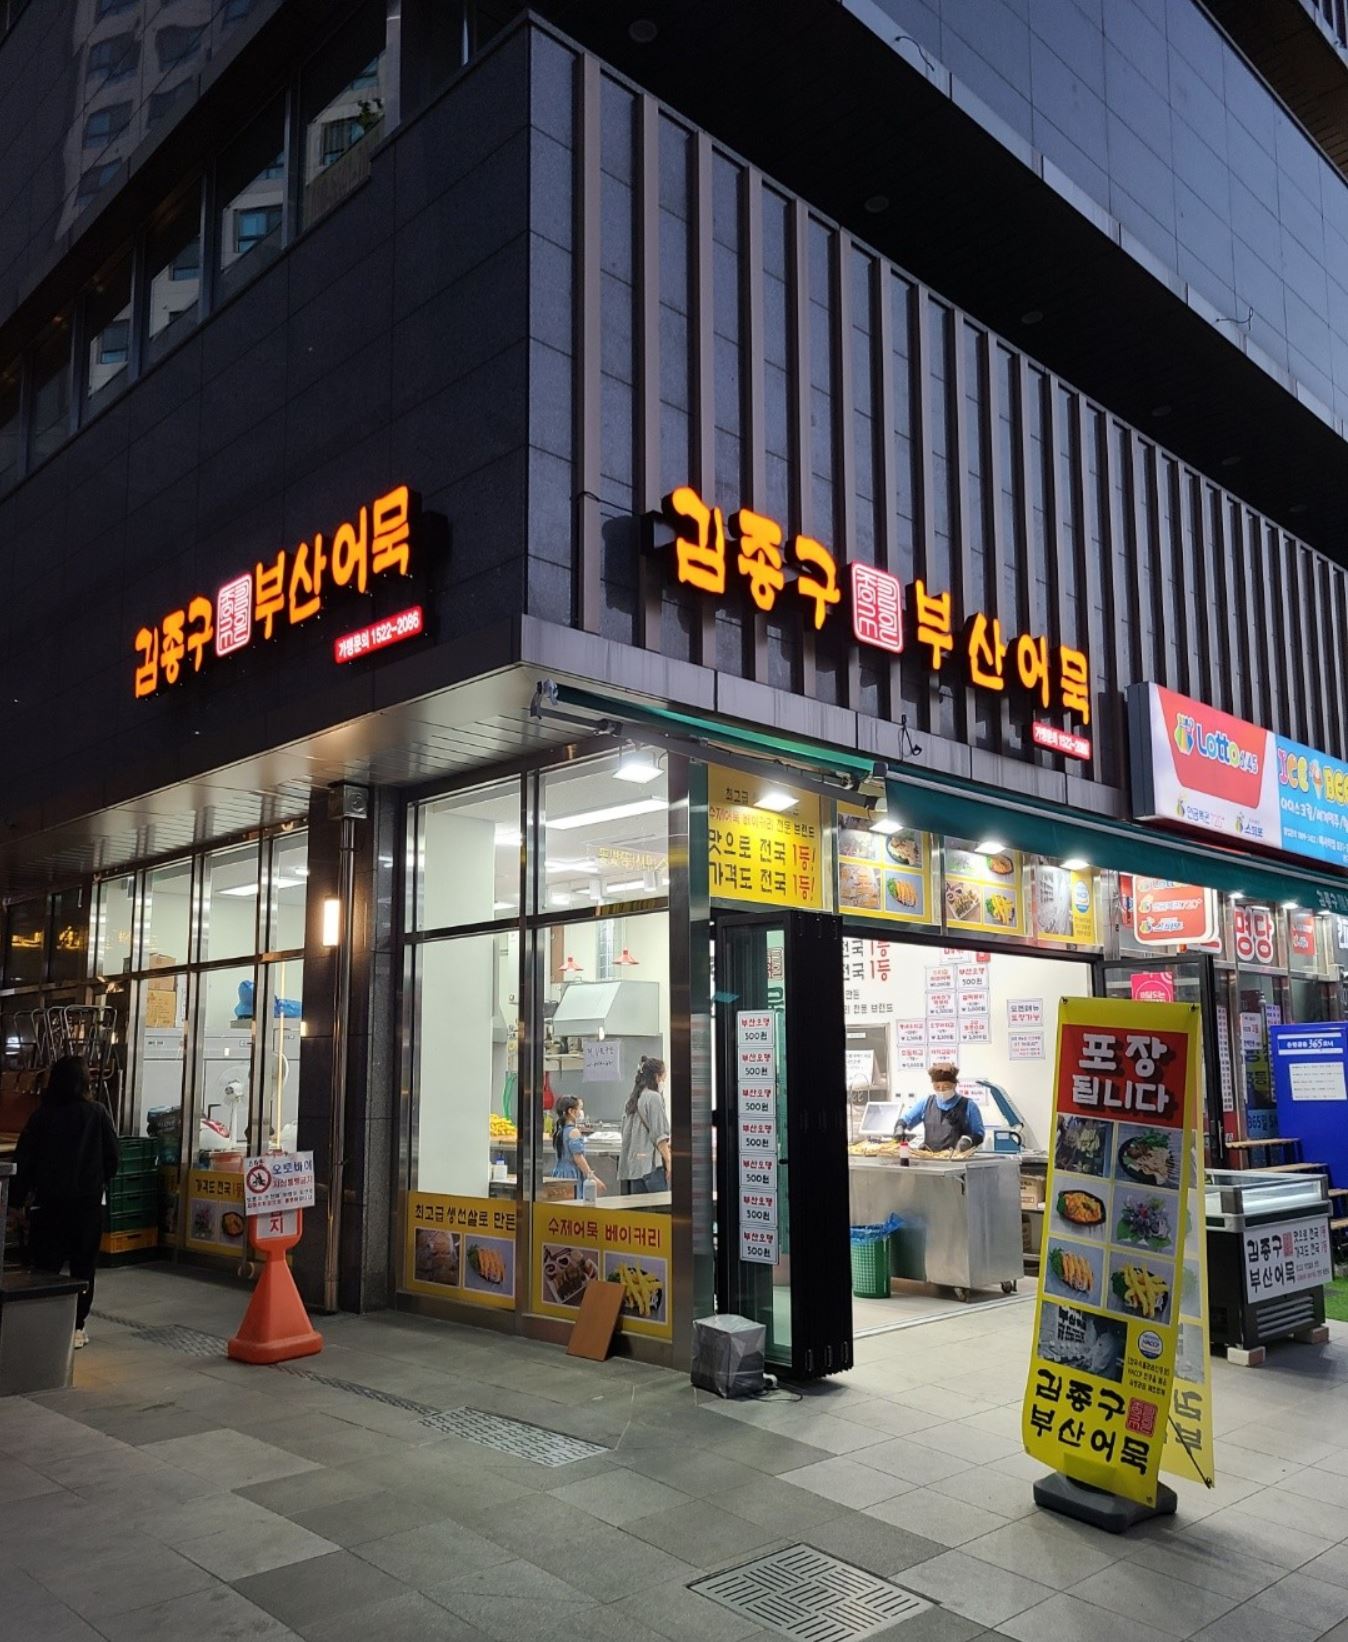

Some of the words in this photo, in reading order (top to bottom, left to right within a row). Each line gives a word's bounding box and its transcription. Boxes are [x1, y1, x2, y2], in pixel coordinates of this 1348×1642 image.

[135, 596, 213, 698] 김종구
[255, 486, 410, 640] 부산어묵
[672, 486, 840, 629] 김종구
[916, 579, 1090, 724] 부산어묵
[1196, 723, 1239, 768] Lotto
[726, 787, 748, 804] 최고급
[794, 824, 815, 839] 브랜드
[709, 829, 751, 858] 맛으로
[760, 838, 786, 866] 전국
[709, 862, 752, 889] 가격도
[760, 869, 786, 896] 전국
[870, 959, 890, 981] 1등
[745, 1031, 767, 1040] 500원
[1079, 1033, 1167, 1077] 포장
[745, 1067, 767, 1076] 500원
[745, 1102, 768, 1112] 500원
[1072, 1074, 1170, 1113] 됩니다
[746, 1138, 768, 1148] 500원
[746, 1174, 769, 1184] 500원
[415, 1204, 444, 1223] 최고급
[447, 1207, 488, 1227] 생선살로
[494, 1212, 517, 1231] 만든
[747, 1210, 769, 1220] 500원
[548, 1217, 598, 1240] 수제어묵
[605, 1224, 661, 1248] 베이커리
[747, 1246, 770, 1257] 500원
[1247, 1235, 1282, 1262] 김종구
[1249, 1261, 1296, 1293] 부산어묵
[1036, 1369, 1125, 1421] 김종구
[1030, 1404, 1150, 1475] 부산어묵
